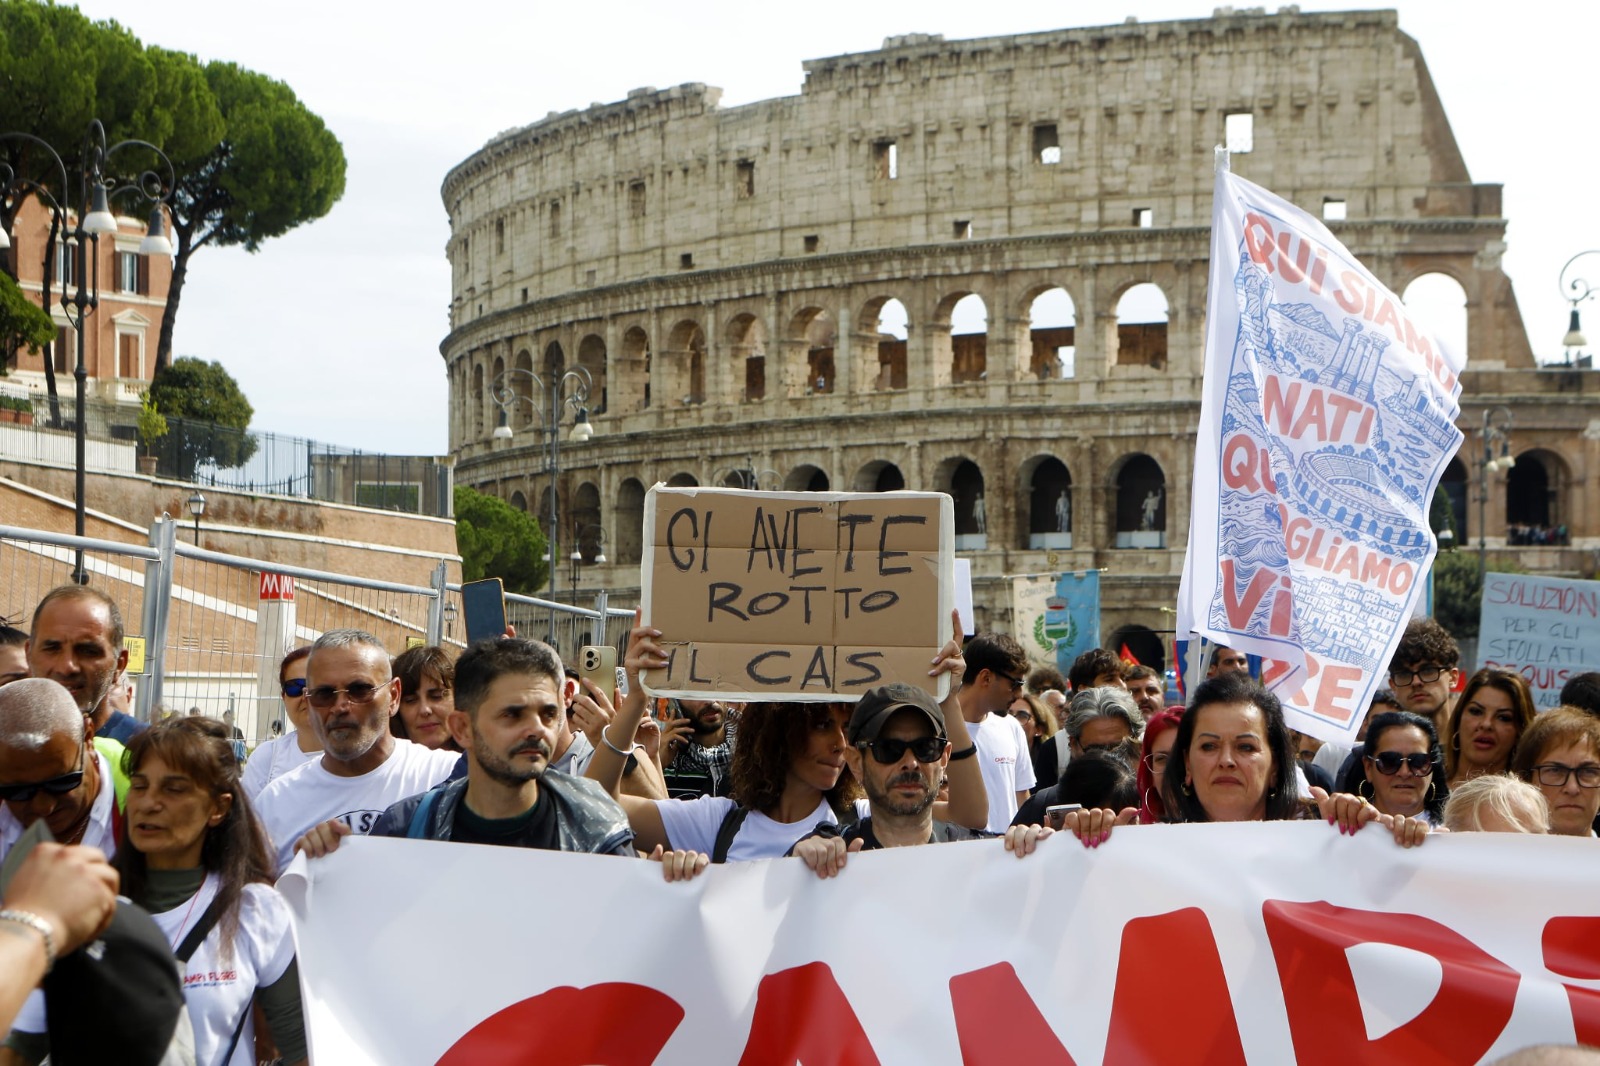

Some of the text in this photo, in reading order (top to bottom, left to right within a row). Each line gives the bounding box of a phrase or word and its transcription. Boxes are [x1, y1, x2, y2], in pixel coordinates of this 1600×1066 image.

[1264, 375, 1375, 444] NATI
[667, 507, 926, 579] CI AVETE
[708, 582, 899, 624] ROTTO
[1502, 617, 1580, 640] PER GLI
[666, 646, 883, 690] IL CAS
[1489, 639, 1584, 664] SFOLLATI
